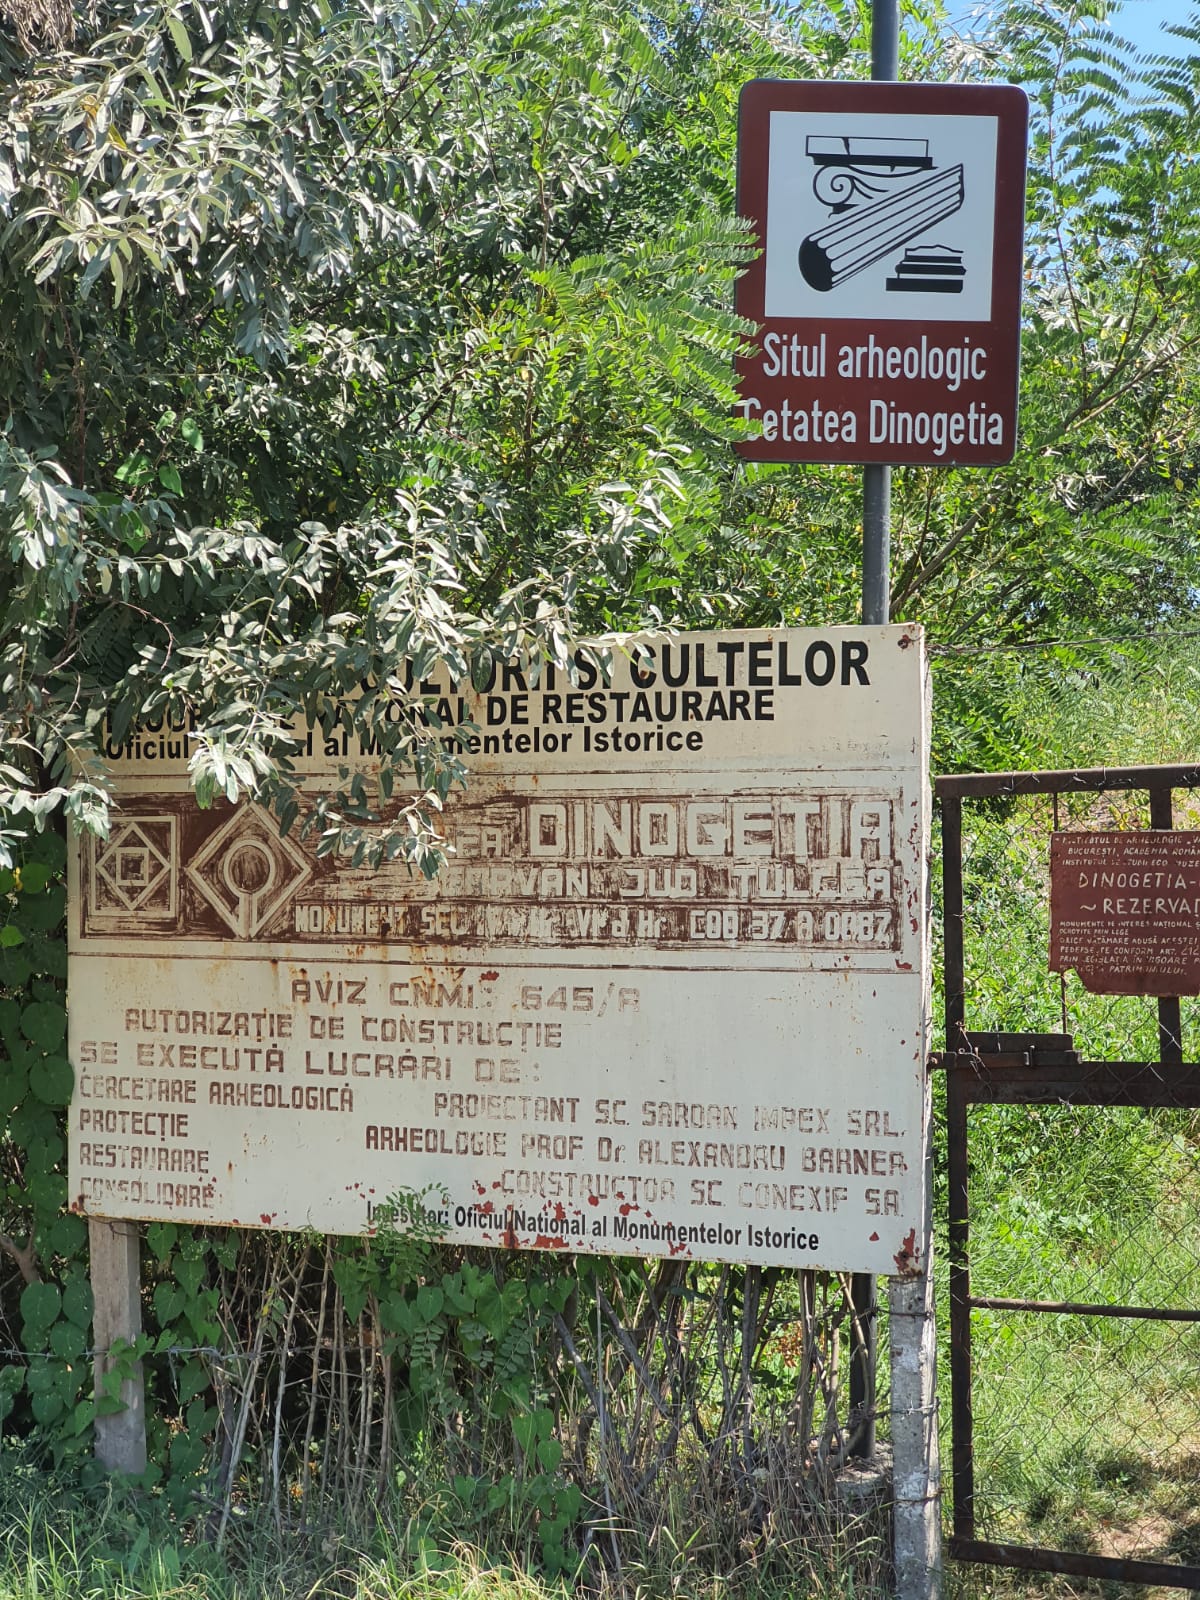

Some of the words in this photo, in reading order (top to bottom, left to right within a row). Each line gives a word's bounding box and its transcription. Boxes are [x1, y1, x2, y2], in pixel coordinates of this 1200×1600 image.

[763, 332, 826, 378] Situl
[838, 335, 988, 392] arheologic
[869, 400, 1004, 456] Dinogetia
[630, 640, 871, 689] CULTELOR
[487, 694, 529, 726] DE
[543, 689, 775, 725] RESTAURARE
[105, 735, 190, 760] Oficiul
[323, 731, 348, 757] al
[583, 725, 704, 752] Istorice
[529, 800, 892, 858] DINOGETIA
[1111, 928, 1129, 936] LEGE
[291, 978, 367, 1005] AVIZ
[309, 1015, 345, 1041] DE
[79, 1040, 118, 1065] SE
[79, 1075, 197, 1104] CERCETARE
[754, 1105, 831, 1134] IMPEX
[79, 1142, 210, 1174] RESTAURARE
[365, 1124, 507, 1158] ARHEOLOGIE
[801, 1146, 909, 1177] BARNEA
[514, 1209, 586, 1236] National
[592, 1215, 607, 1238] al
[614, 1216, 742, 1246] Monumentelor
[748, 1224, 820, 1252] Istorice
